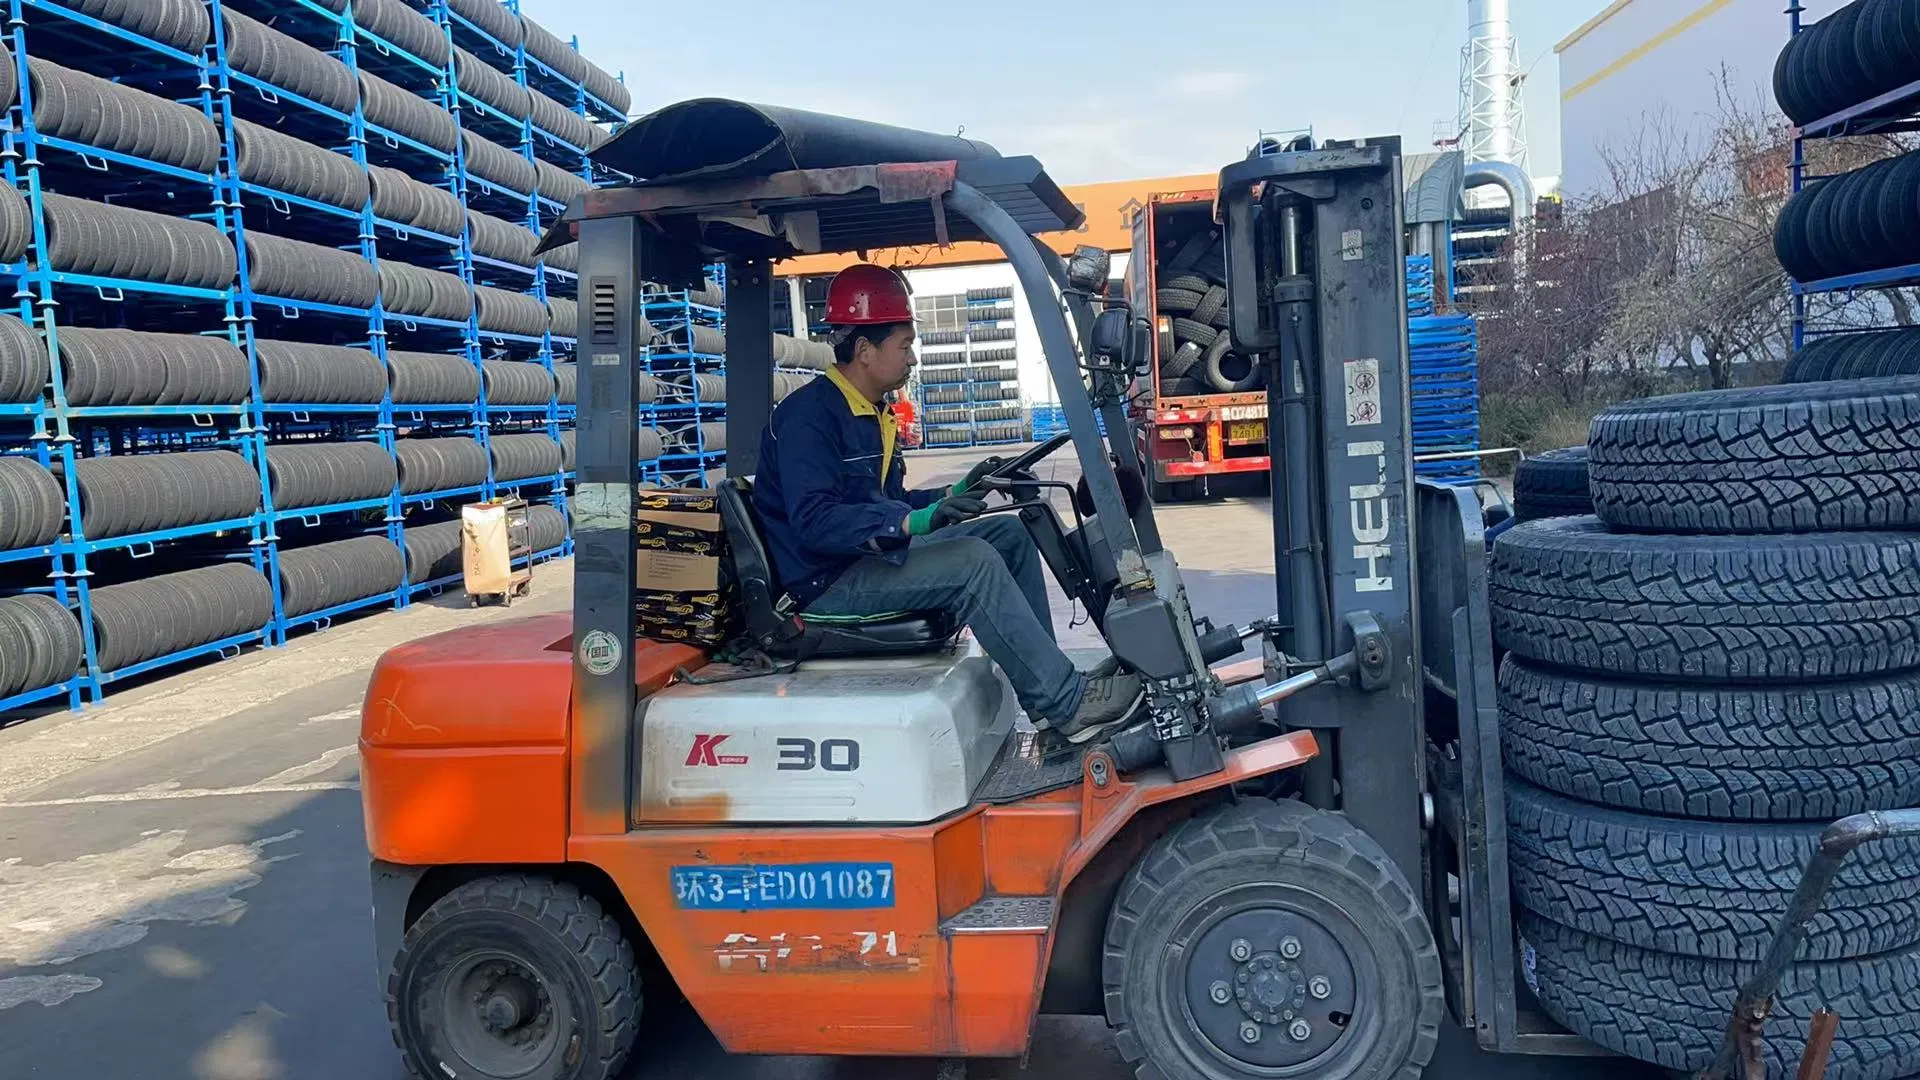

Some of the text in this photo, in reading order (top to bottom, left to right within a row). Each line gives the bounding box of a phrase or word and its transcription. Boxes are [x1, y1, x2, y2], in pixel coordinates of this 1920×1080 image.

[1346, 440, 1394, 593] HELI
[684, 733, 731, 767] K
[776, 737, 860, 772] 30
